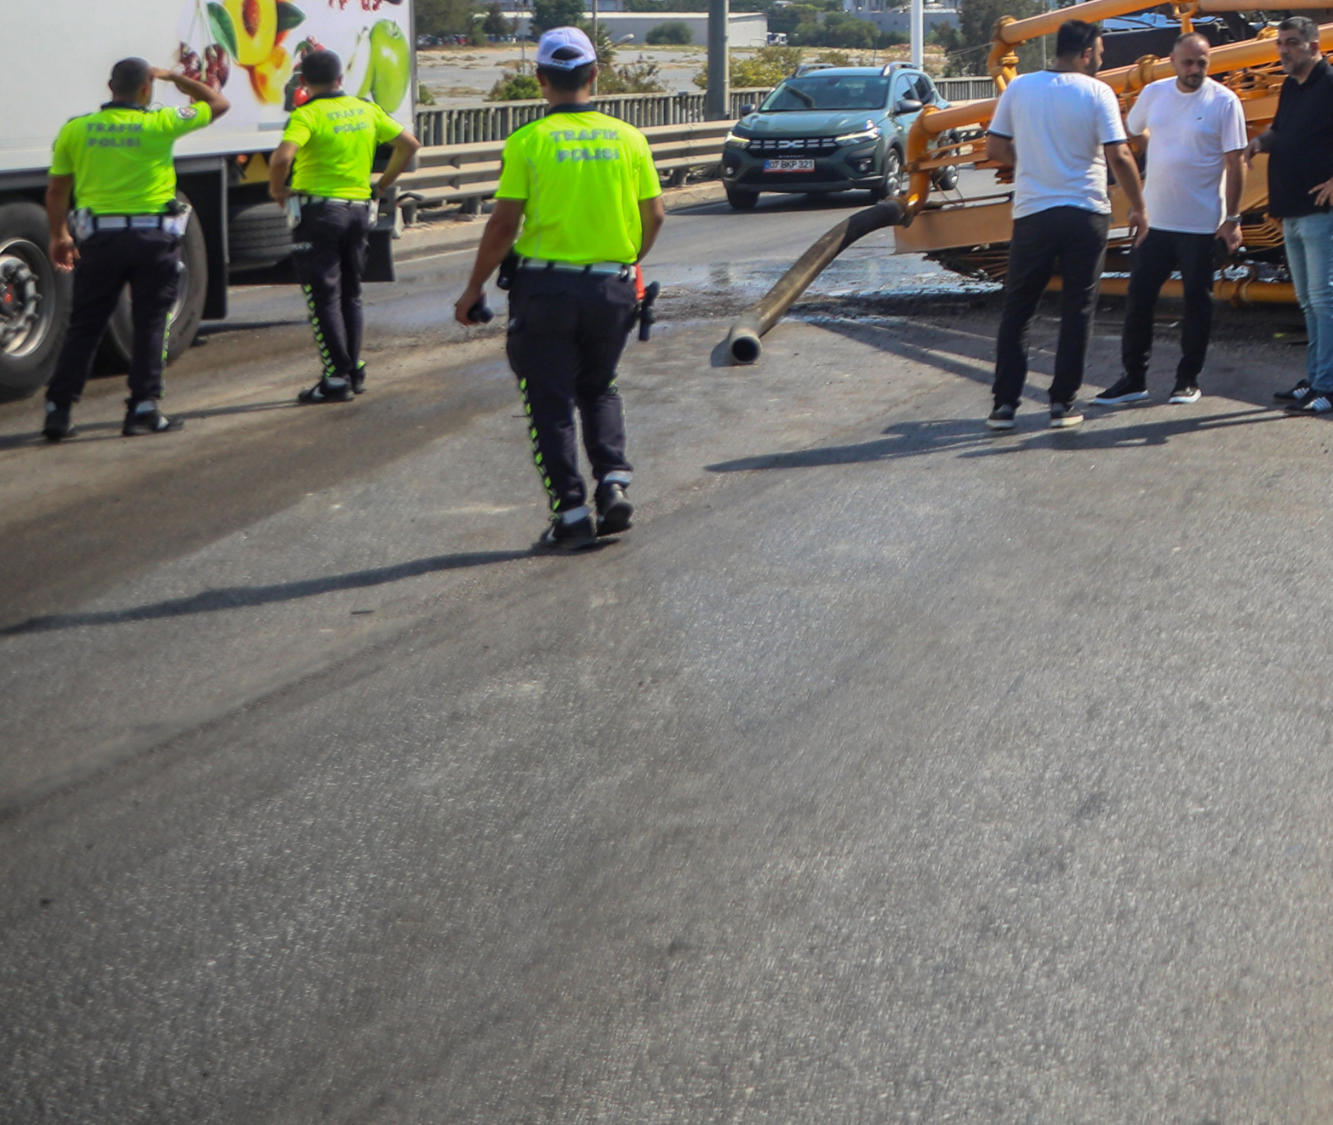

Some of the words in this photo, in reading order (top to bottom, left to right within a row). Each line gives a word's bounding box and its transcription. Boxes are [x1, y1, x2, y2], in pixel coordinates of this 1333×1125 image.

[770, 160, 780, 168] 07
[781, 160, 797, 168] BKP
[798, 160, 813, 168] 321
